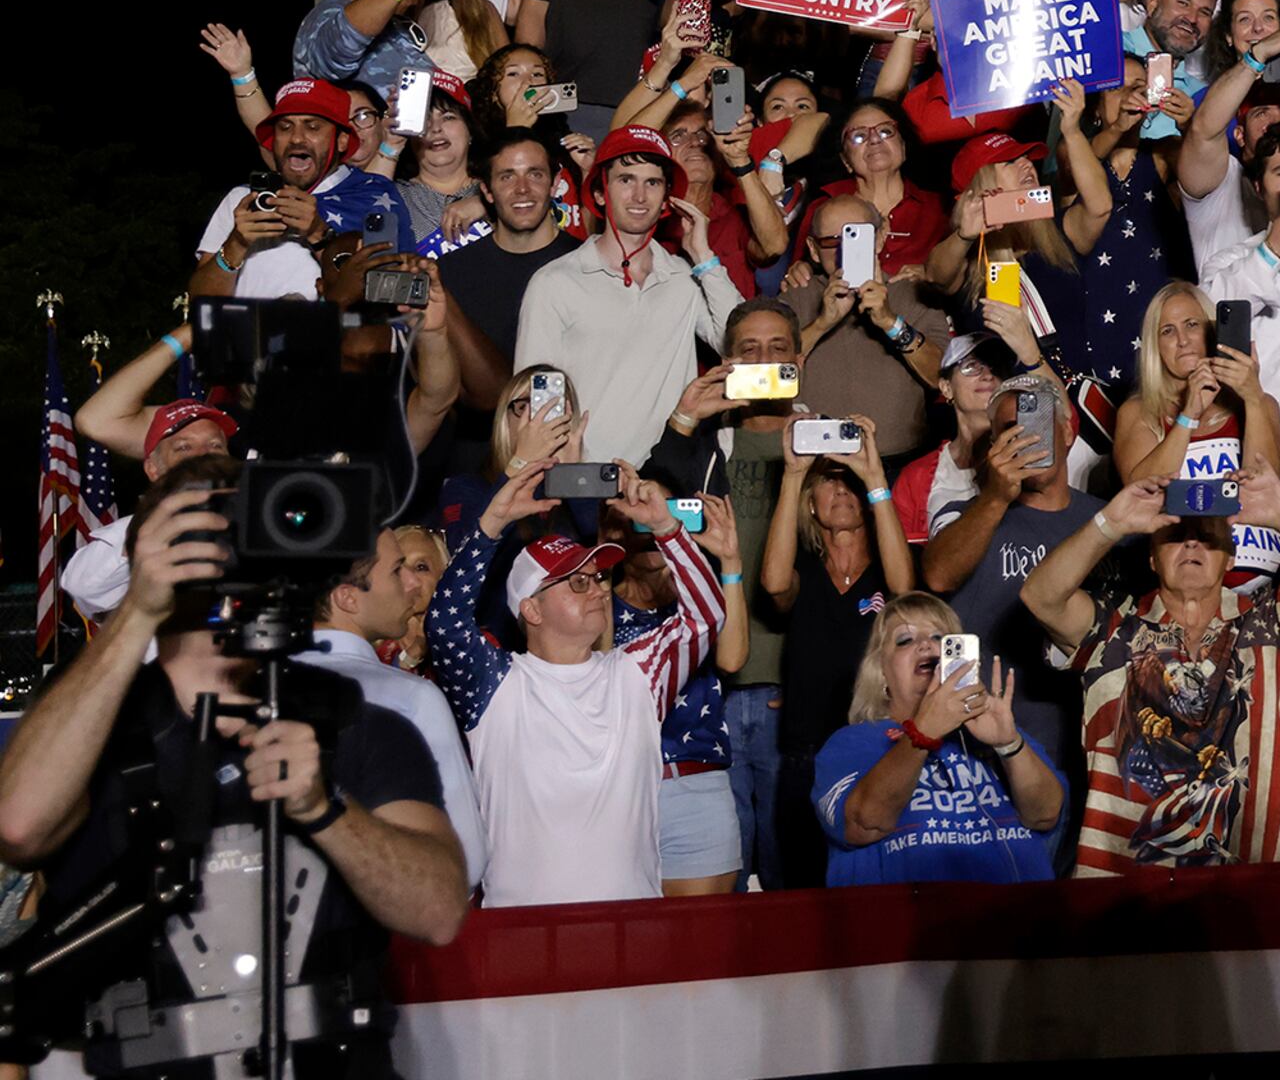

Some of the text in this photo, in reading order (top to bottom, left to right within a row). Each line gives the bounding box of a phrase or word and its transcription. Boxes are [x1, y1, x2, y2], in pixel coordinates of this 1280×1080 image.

[962, 1, 1101, 46] AMRICA
[985, 28, 1086, 66] GEAT
[988, 53, 1093, 92] AAIN!
[1186, 452, 1240, 477] MA
[909, 788, 1002, 814] 2024
[884, 819, 1033, 855] TAKE AMERICA BACK
